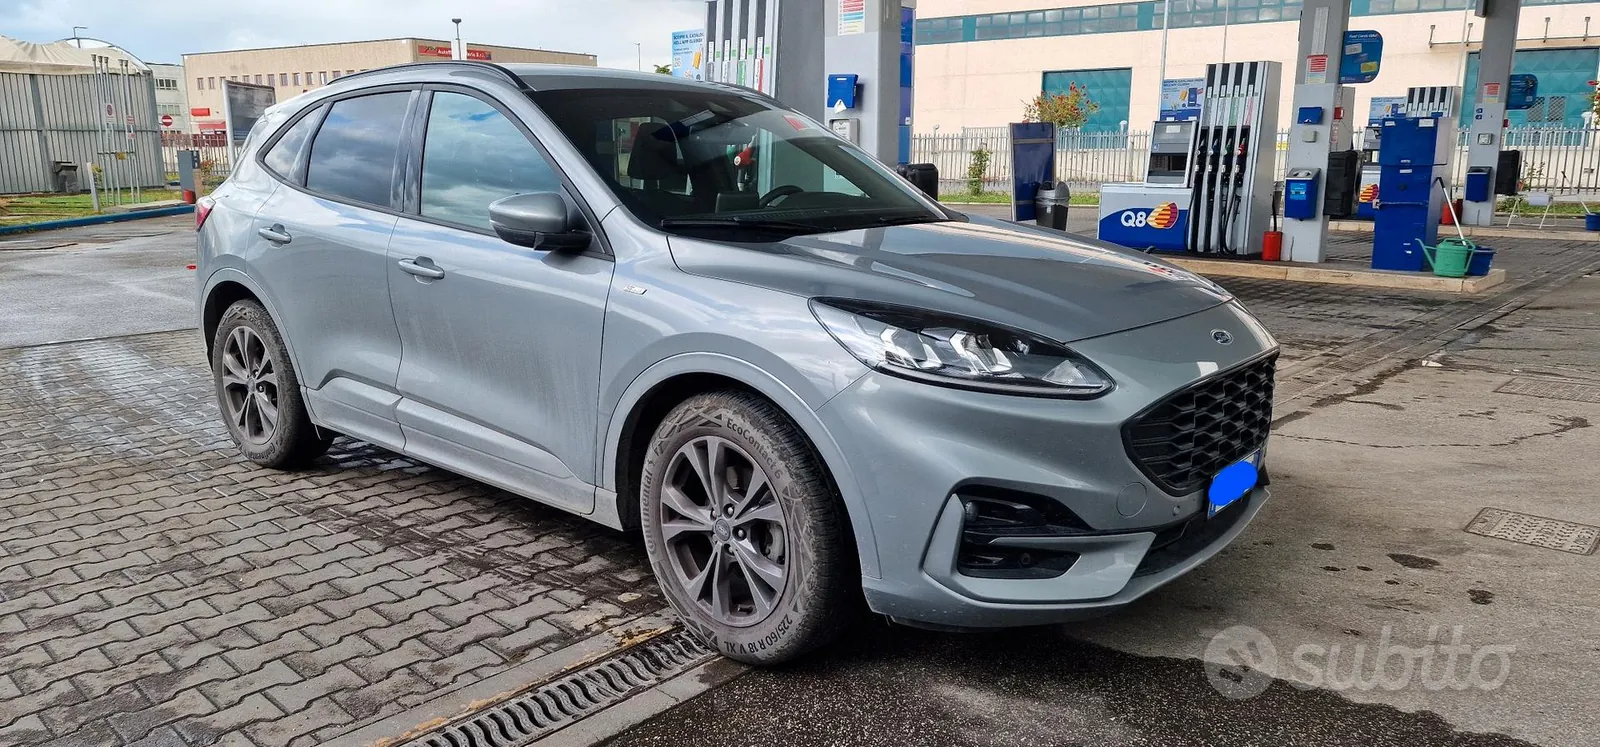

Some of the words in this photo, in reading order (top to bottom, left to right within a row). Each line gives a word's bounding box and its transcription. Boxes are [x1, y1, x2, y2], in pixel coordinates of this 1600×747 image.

[1121, 210, 1147, 228] Q8
[727, 418, 776, 470] EcoContact
[774, 470, 783, 479] 6
[642, 468, 656, 555] Continental
[765, 613, 793, 646] 225/60
[723, 641, 737, 654] XL
[739, 643, 747, 655] V
[748, 641, 759, 653] 18
[757, 639, 766, 650] R
